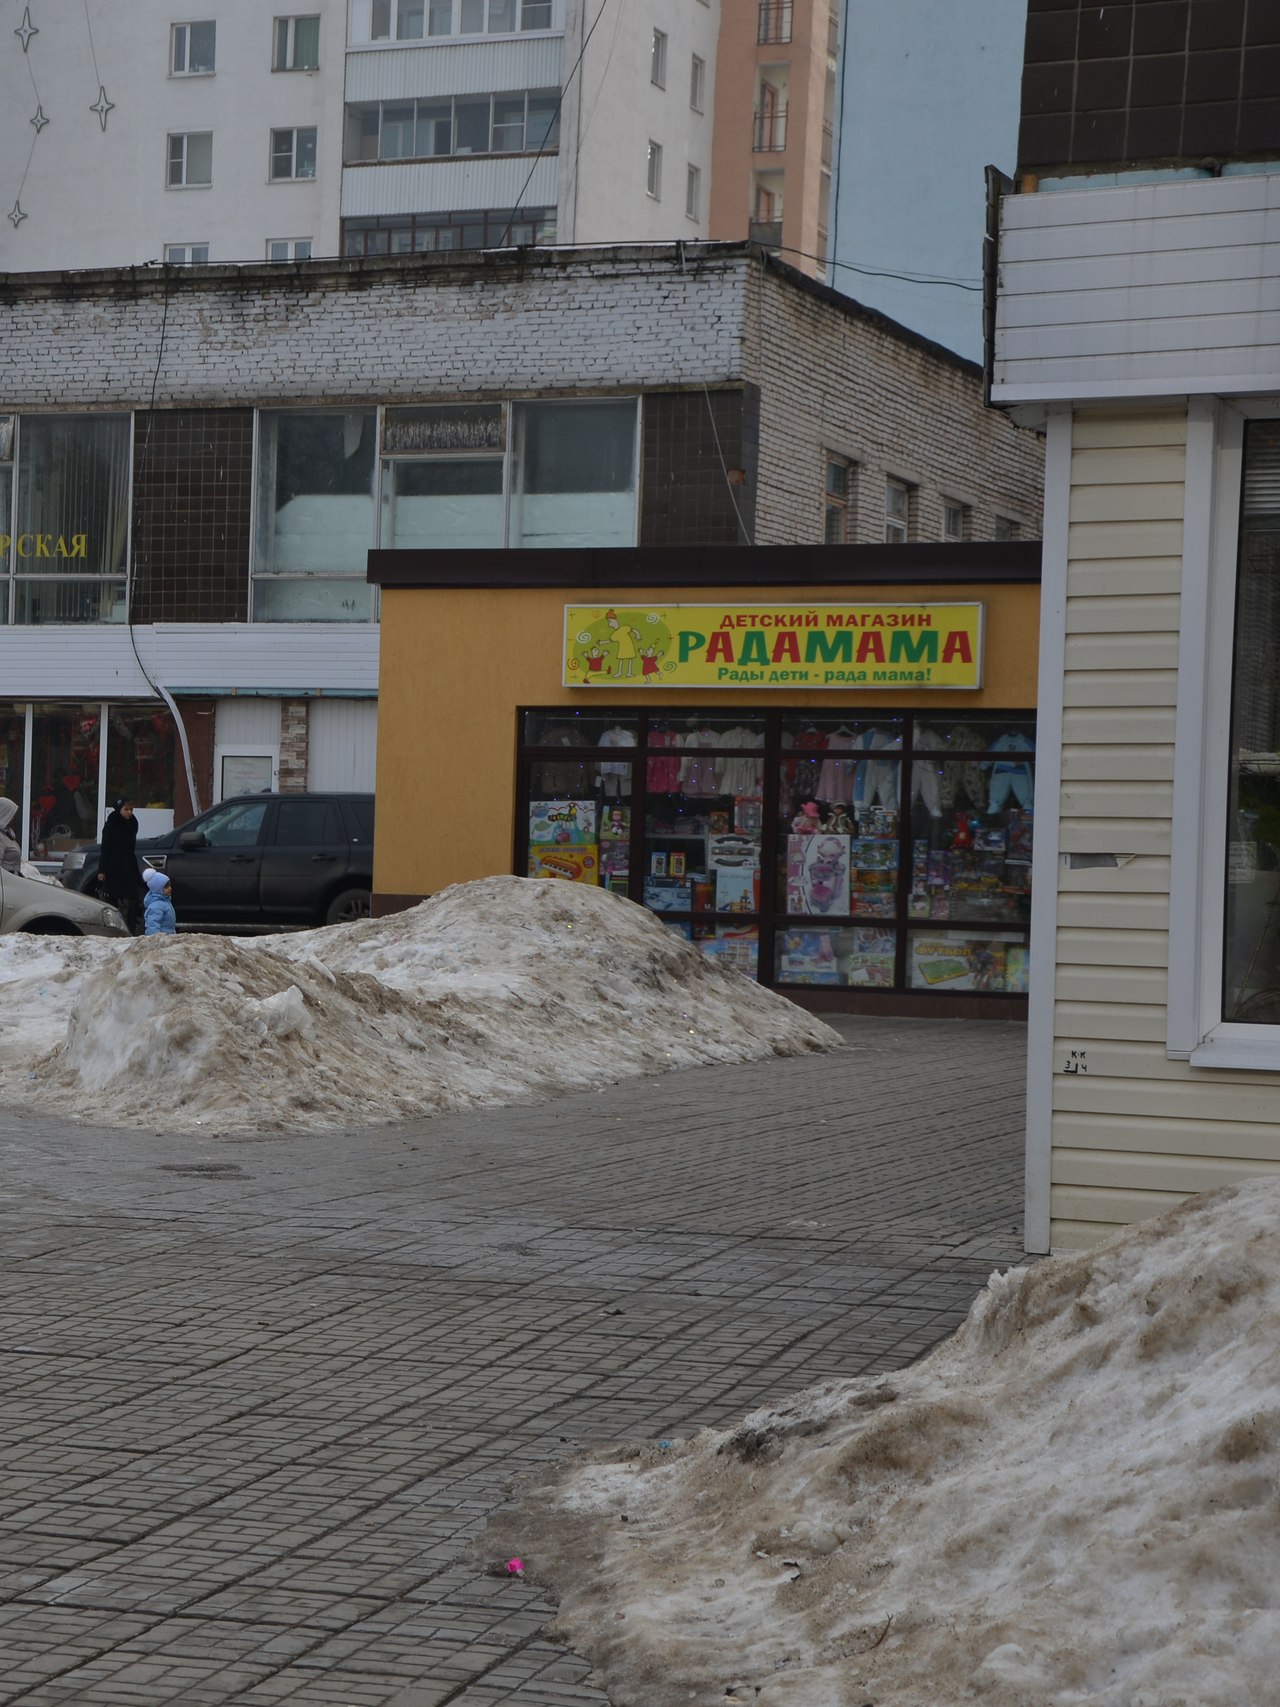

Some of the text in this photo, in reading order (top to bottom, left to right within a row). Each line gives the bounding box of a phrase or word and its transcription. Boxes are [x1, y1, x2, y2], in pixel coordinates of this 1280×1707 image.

[720, 611, 932, 629] ДЕТСКИЙ МАГАЗИН
[677, 630, 972, 666] РАДАМАМА
[718, 667, 764, 681] Рады
[769, 669, 808, 682] дети
[825, 670, 868, 683] рада
[873, 668, 931, 681] мама!
[915, 945, 973, 957] ФУТБОЛ
